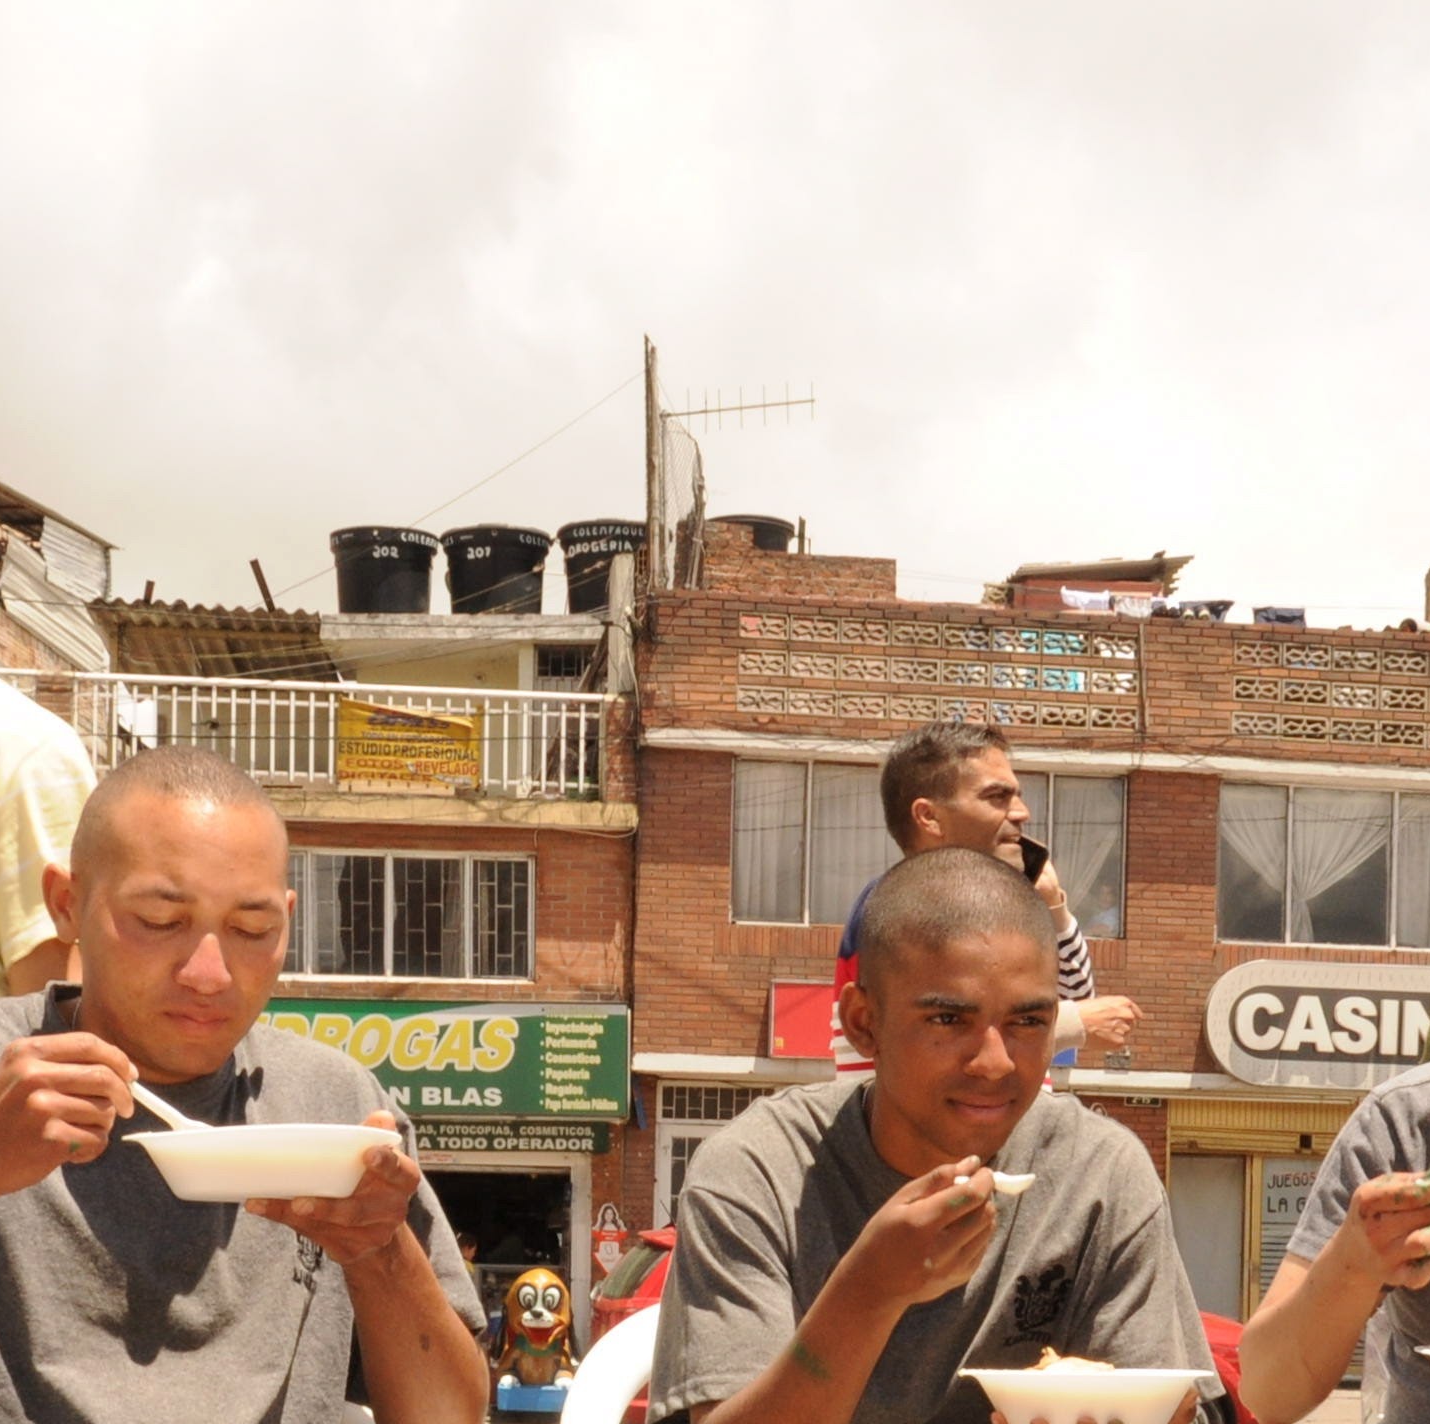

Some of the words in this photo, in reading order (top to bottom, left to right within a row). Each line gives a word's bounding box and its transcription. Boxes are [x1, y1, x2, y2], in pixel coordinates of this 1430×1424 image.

[372, 545, 399, 559] 202
[338, 741, 393, 756] ESTUDIO
[393, 744, 477, 761] PROFESIONAL
[344, 757, 404, 770] FOTOS
[414, 760, 480, 776] REVELADO
[422, 1086, 503, 1107] BLAS
[439, 1124, 514, 1137] FOTOCOPIAS,
[519, 1126, 595, 1138] COSMETICOS,
[437, 1137, 488, 1149] TODO
[493, 1138, 594, 1151] OPERADOR
[1267, 1196, 1289, 1213] LA
